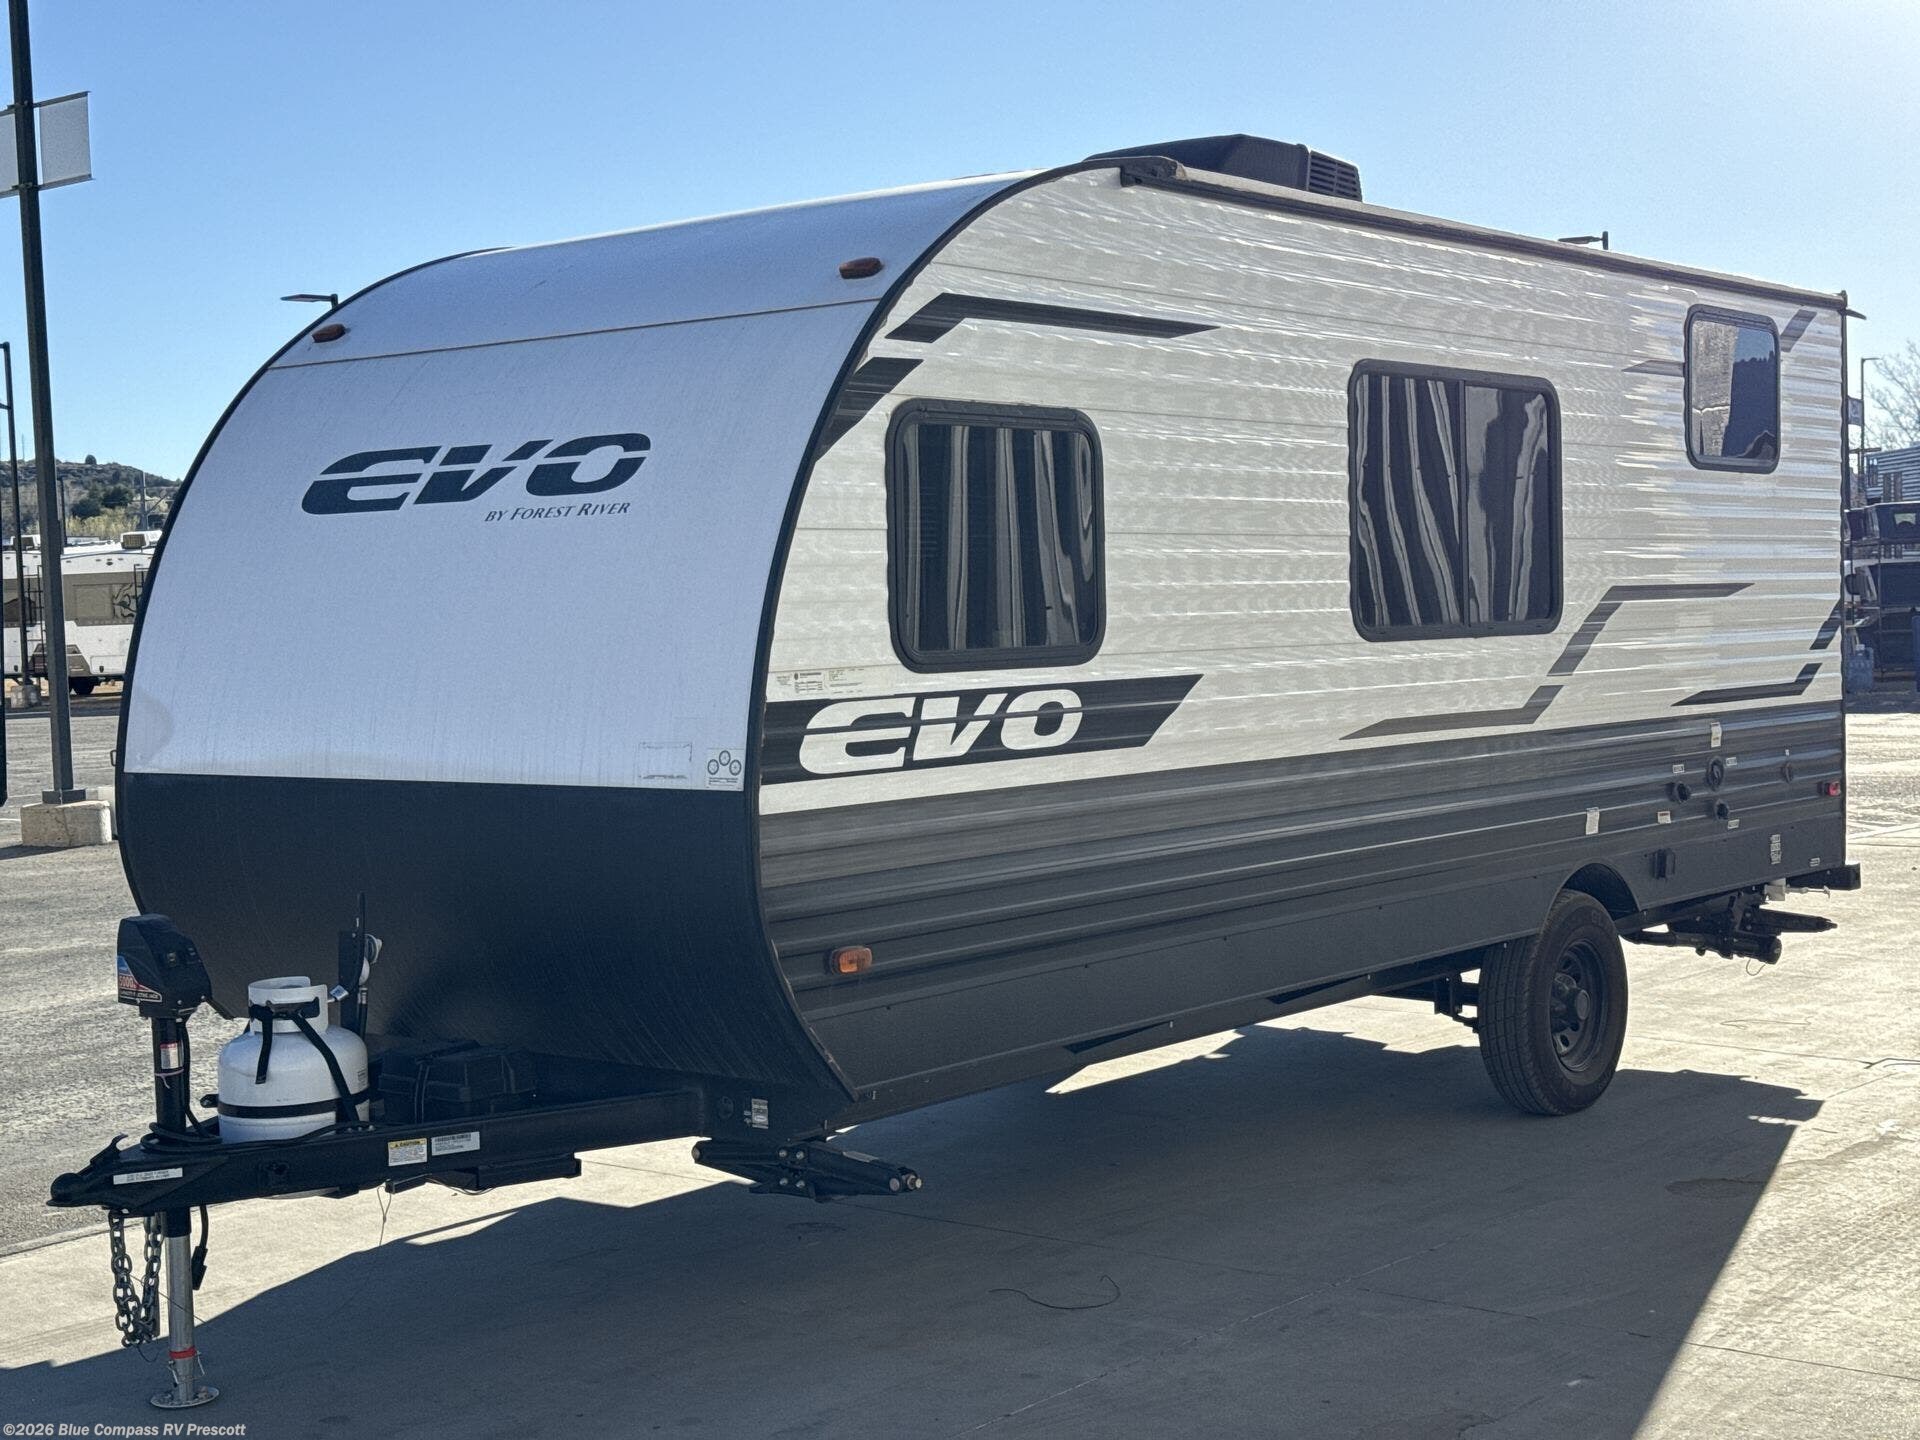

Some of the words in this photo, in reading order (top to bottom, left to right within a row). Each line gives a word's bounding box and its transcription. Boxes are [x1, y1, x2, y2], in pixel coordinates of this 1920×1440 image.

[302, 432, 651, 515] EVO
[484, 510, 507, 522] BY
[510, 505, 576, 521] FOREST
[577, 502, 631, 516] RIVER
[799, 689, 1083, 774] EVO
